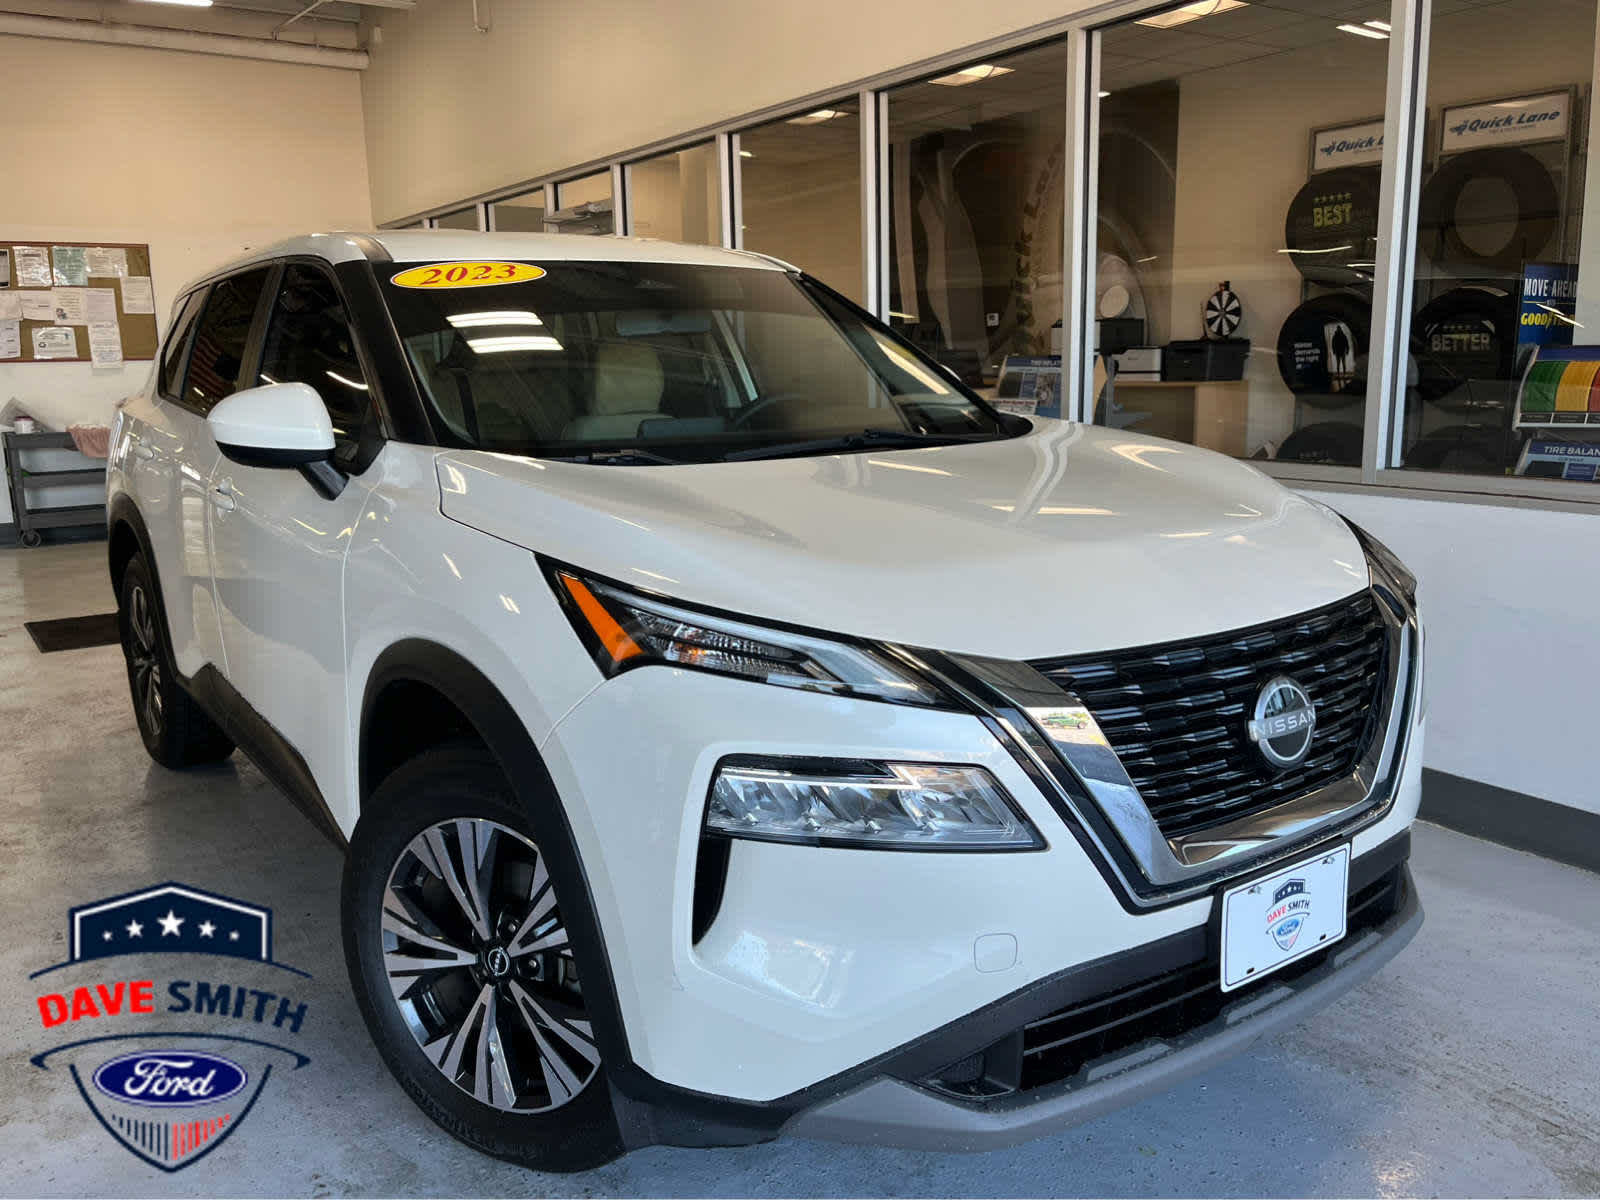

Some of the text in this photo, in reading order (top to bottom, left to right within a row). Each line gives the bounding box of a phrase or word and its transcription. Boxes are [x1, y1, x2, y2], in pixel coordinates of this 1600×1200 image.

[1469, 112, 1514, 133] Quick
[1516, 109, 1561, 126] Lane
[1336, 134, 1376, 153] Quick
[1312, 202, 1353, 229] BEST
[419, 264, 517, 286] 2023
[1523, 278, 1549, 297] MOVE
[1431, 333, 1492, 352] BETTER
[1543, 445, 1567, 455] TIRE
[1252, 704, 1315, 738] NISSAN
[1266, 898, 1310, 924] DAVE SMITH
